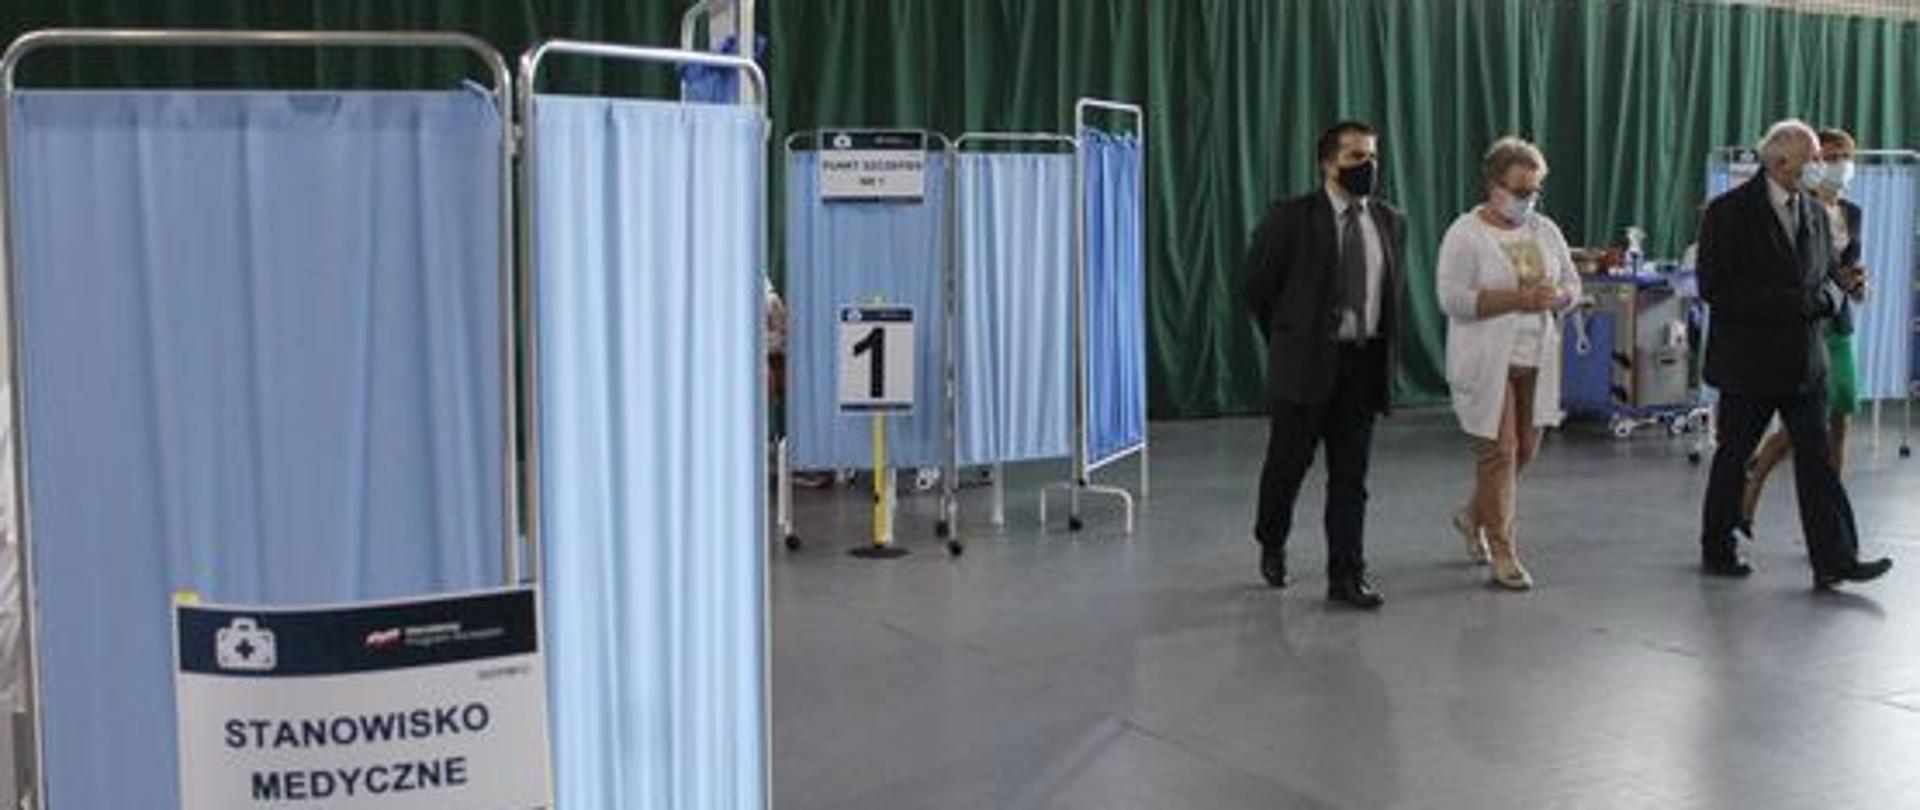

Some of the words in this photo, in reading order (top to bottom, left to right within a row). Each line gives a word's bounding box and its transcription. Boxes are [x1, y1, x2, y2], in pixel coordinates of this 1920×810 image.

[852, 327, 885, 399] 1
[224, 703, 490, 748] STANOWISKO
[251, 757, 467, 801] MEDYCZNE
